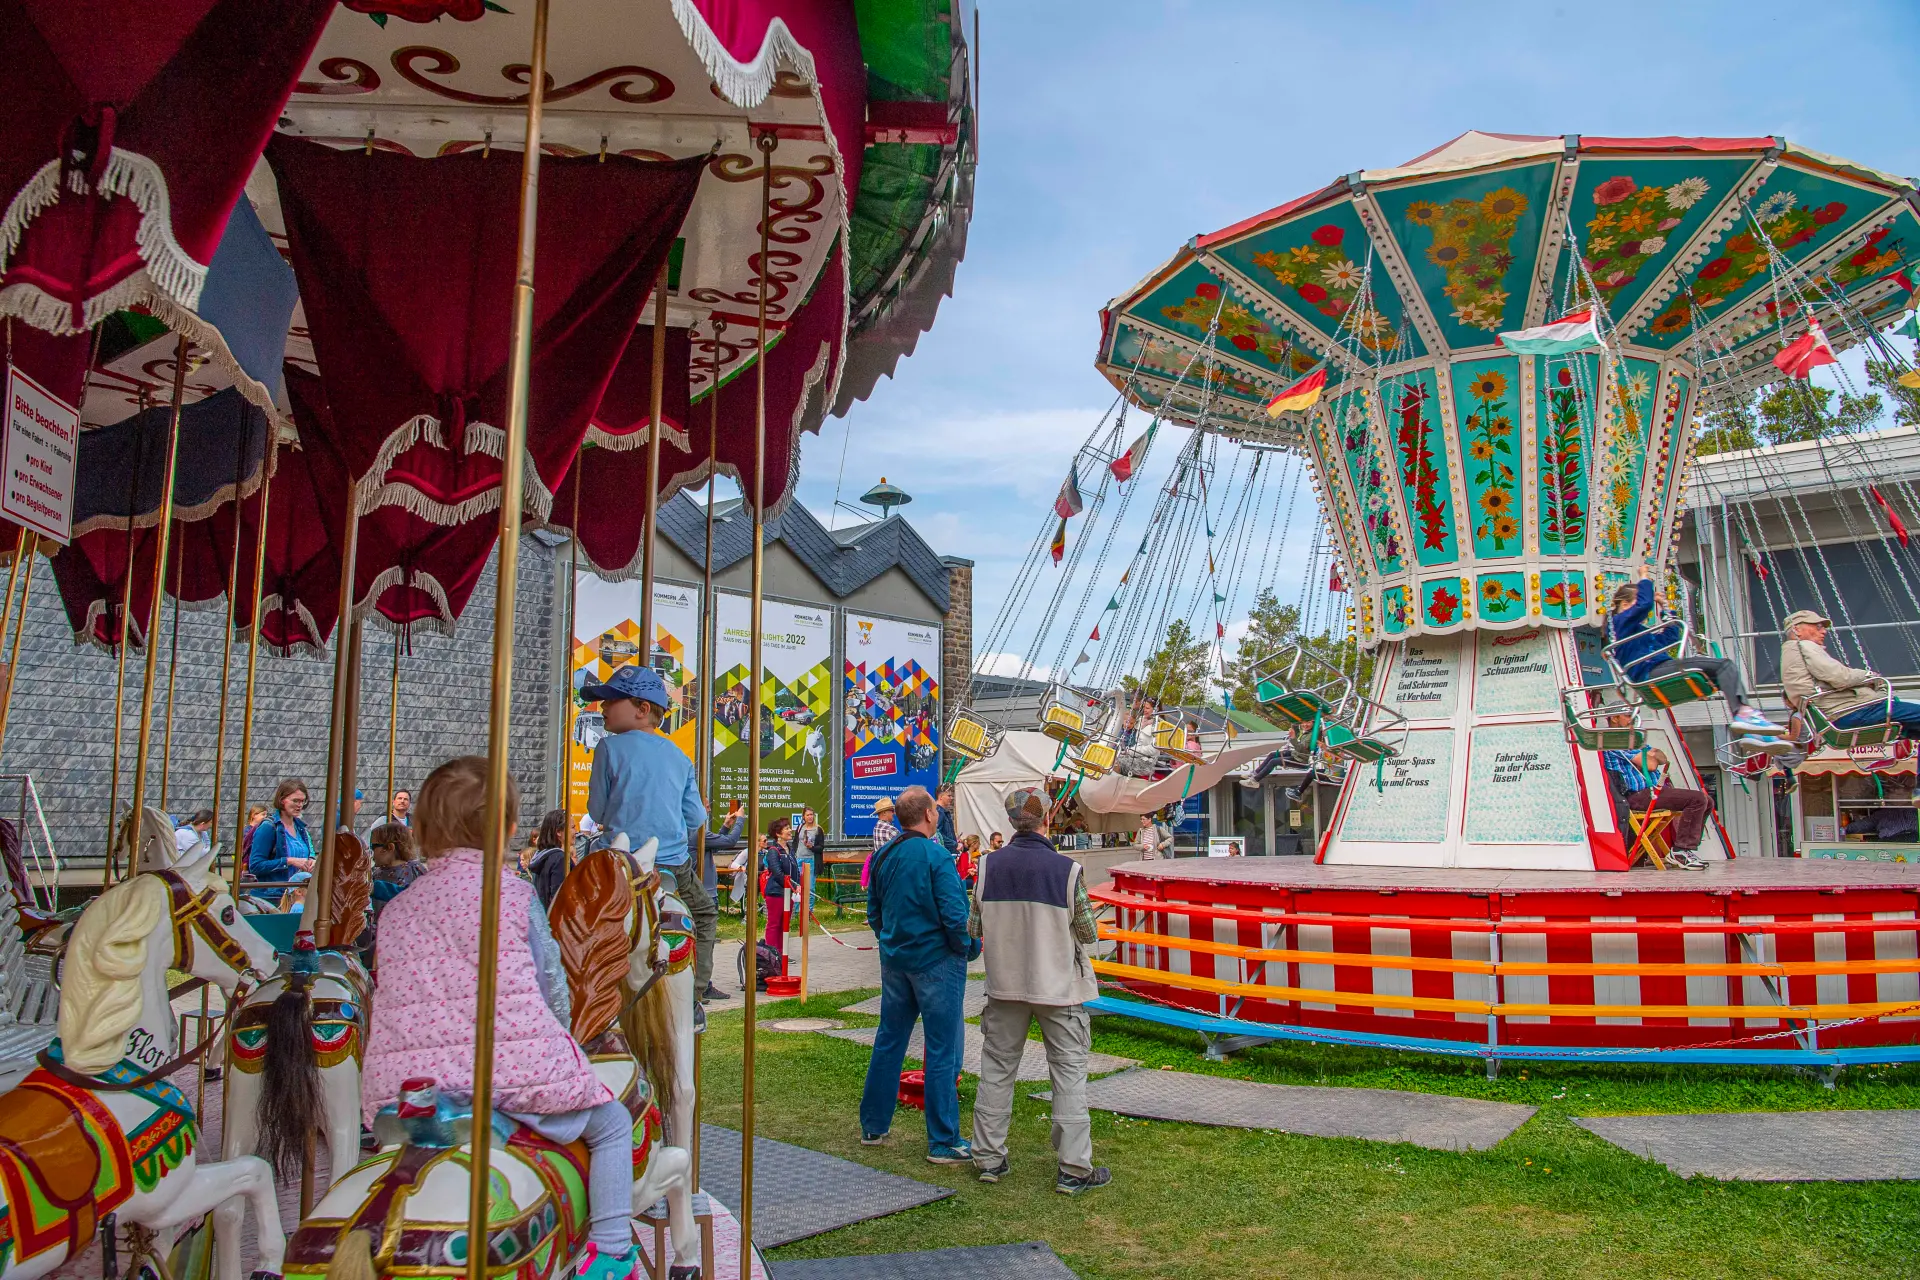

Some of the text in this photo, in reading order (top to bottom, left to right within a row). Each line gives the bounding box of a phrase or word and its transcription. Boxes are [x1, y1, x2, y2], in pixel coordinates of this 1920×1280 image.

[15, 394, 34, 420] Bitte
[35, 408, 69, 441] beachten
[13, 419, 21, 432] Für
[21, 427, 31, 439] eine
[32, 432, 44, 446] Fahrt
[30, 456, 53, 476] pro Kind
[19, 471, 63, 502] pro Erwachsener
[15, 492, 62, 522] pro Begleitperson
[654, 592, 677, 601] KOMMERN
[786, 633, 806, 646] 2022
[1409, 647, 1424, 657] Das
[1494, 653, 1530, 666] Original
[1414, 667, 1450, 678] Flaschen
[1481, 662, 1548, 677] Schwanenflug
[1411, 680, 1449, 690] Schirmen
[1407, 691, 1442, 701] Verboten
[855, 758, 883, 768] MITMACHEN
[1494, 752, 1539, 763] Fahrchips
[573, 761, 593, 771] MAR
[758, 767, 783, 775] ERRÜCKTES
[864, 765, 887, 774] ERLEBEN!
[1394, 767, 1410, 776] Für
[1494, 761, 1551, 773] an der Kasse
[1369, 777, 1430, 787] Klin und Gross
[1492, 772, 1523, 783] lösen!
[793, 816, 804, 826] LV
